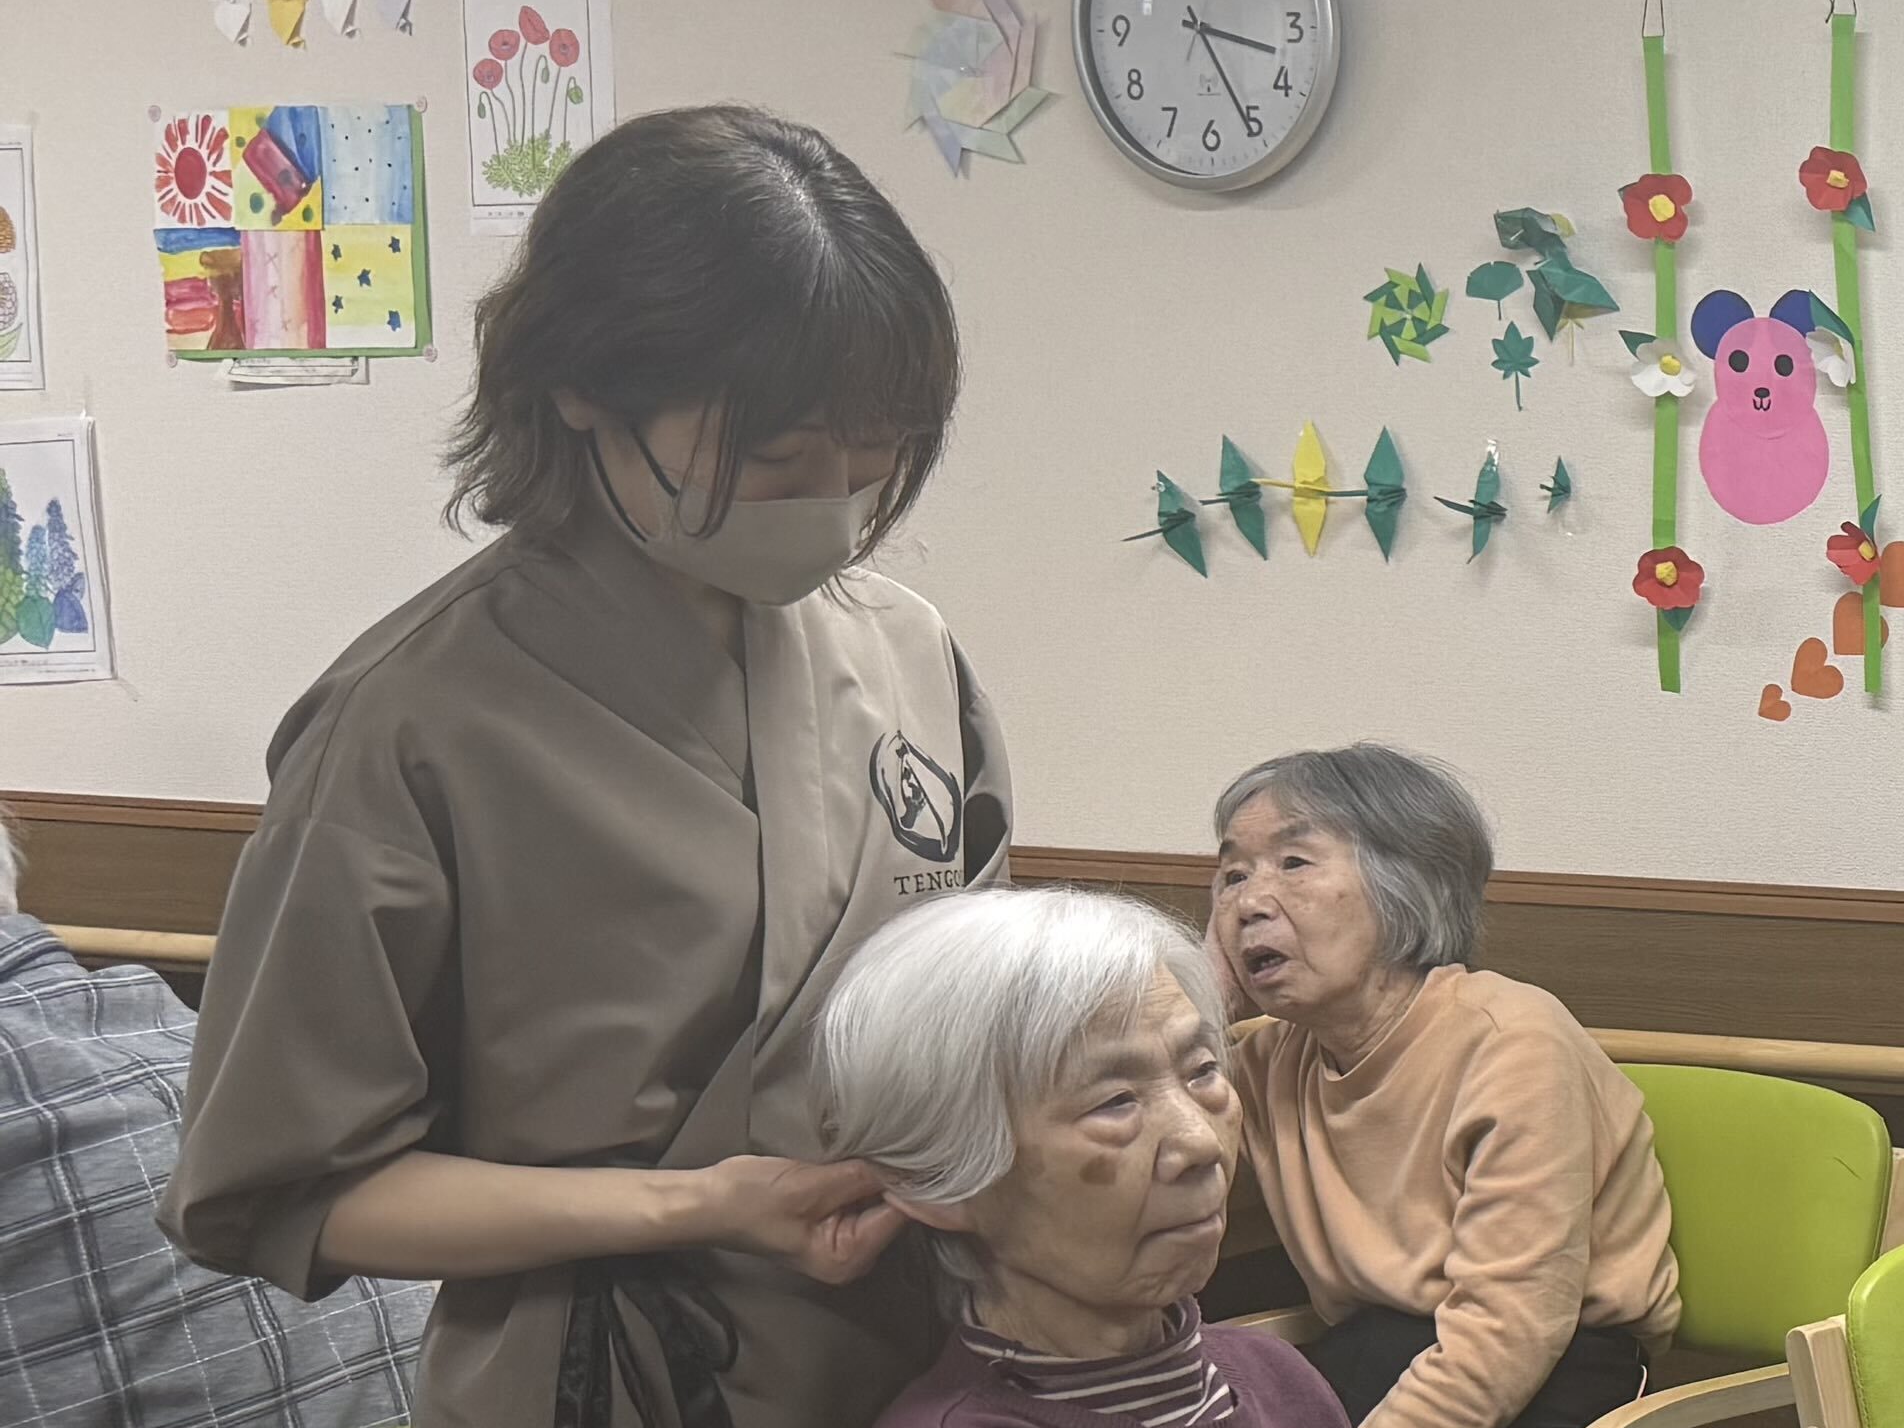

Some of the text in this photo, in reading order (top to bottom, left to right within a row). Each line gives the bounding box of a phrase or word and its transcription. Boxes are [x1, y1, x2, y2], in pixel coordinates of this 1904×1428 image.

[1112, 14, 1131, 47] 9
[1286, 12, 1304, 44] 3
[1126, 68, 1145, 100] 8
[1272, 65, 1293, 98] 4
[1161, 107, 1178, 138] 7
[1201, 119, 1221, 152] 6
[1245, 105, 1263, 138] 5
[893, 869, 966, 896] TENGO
